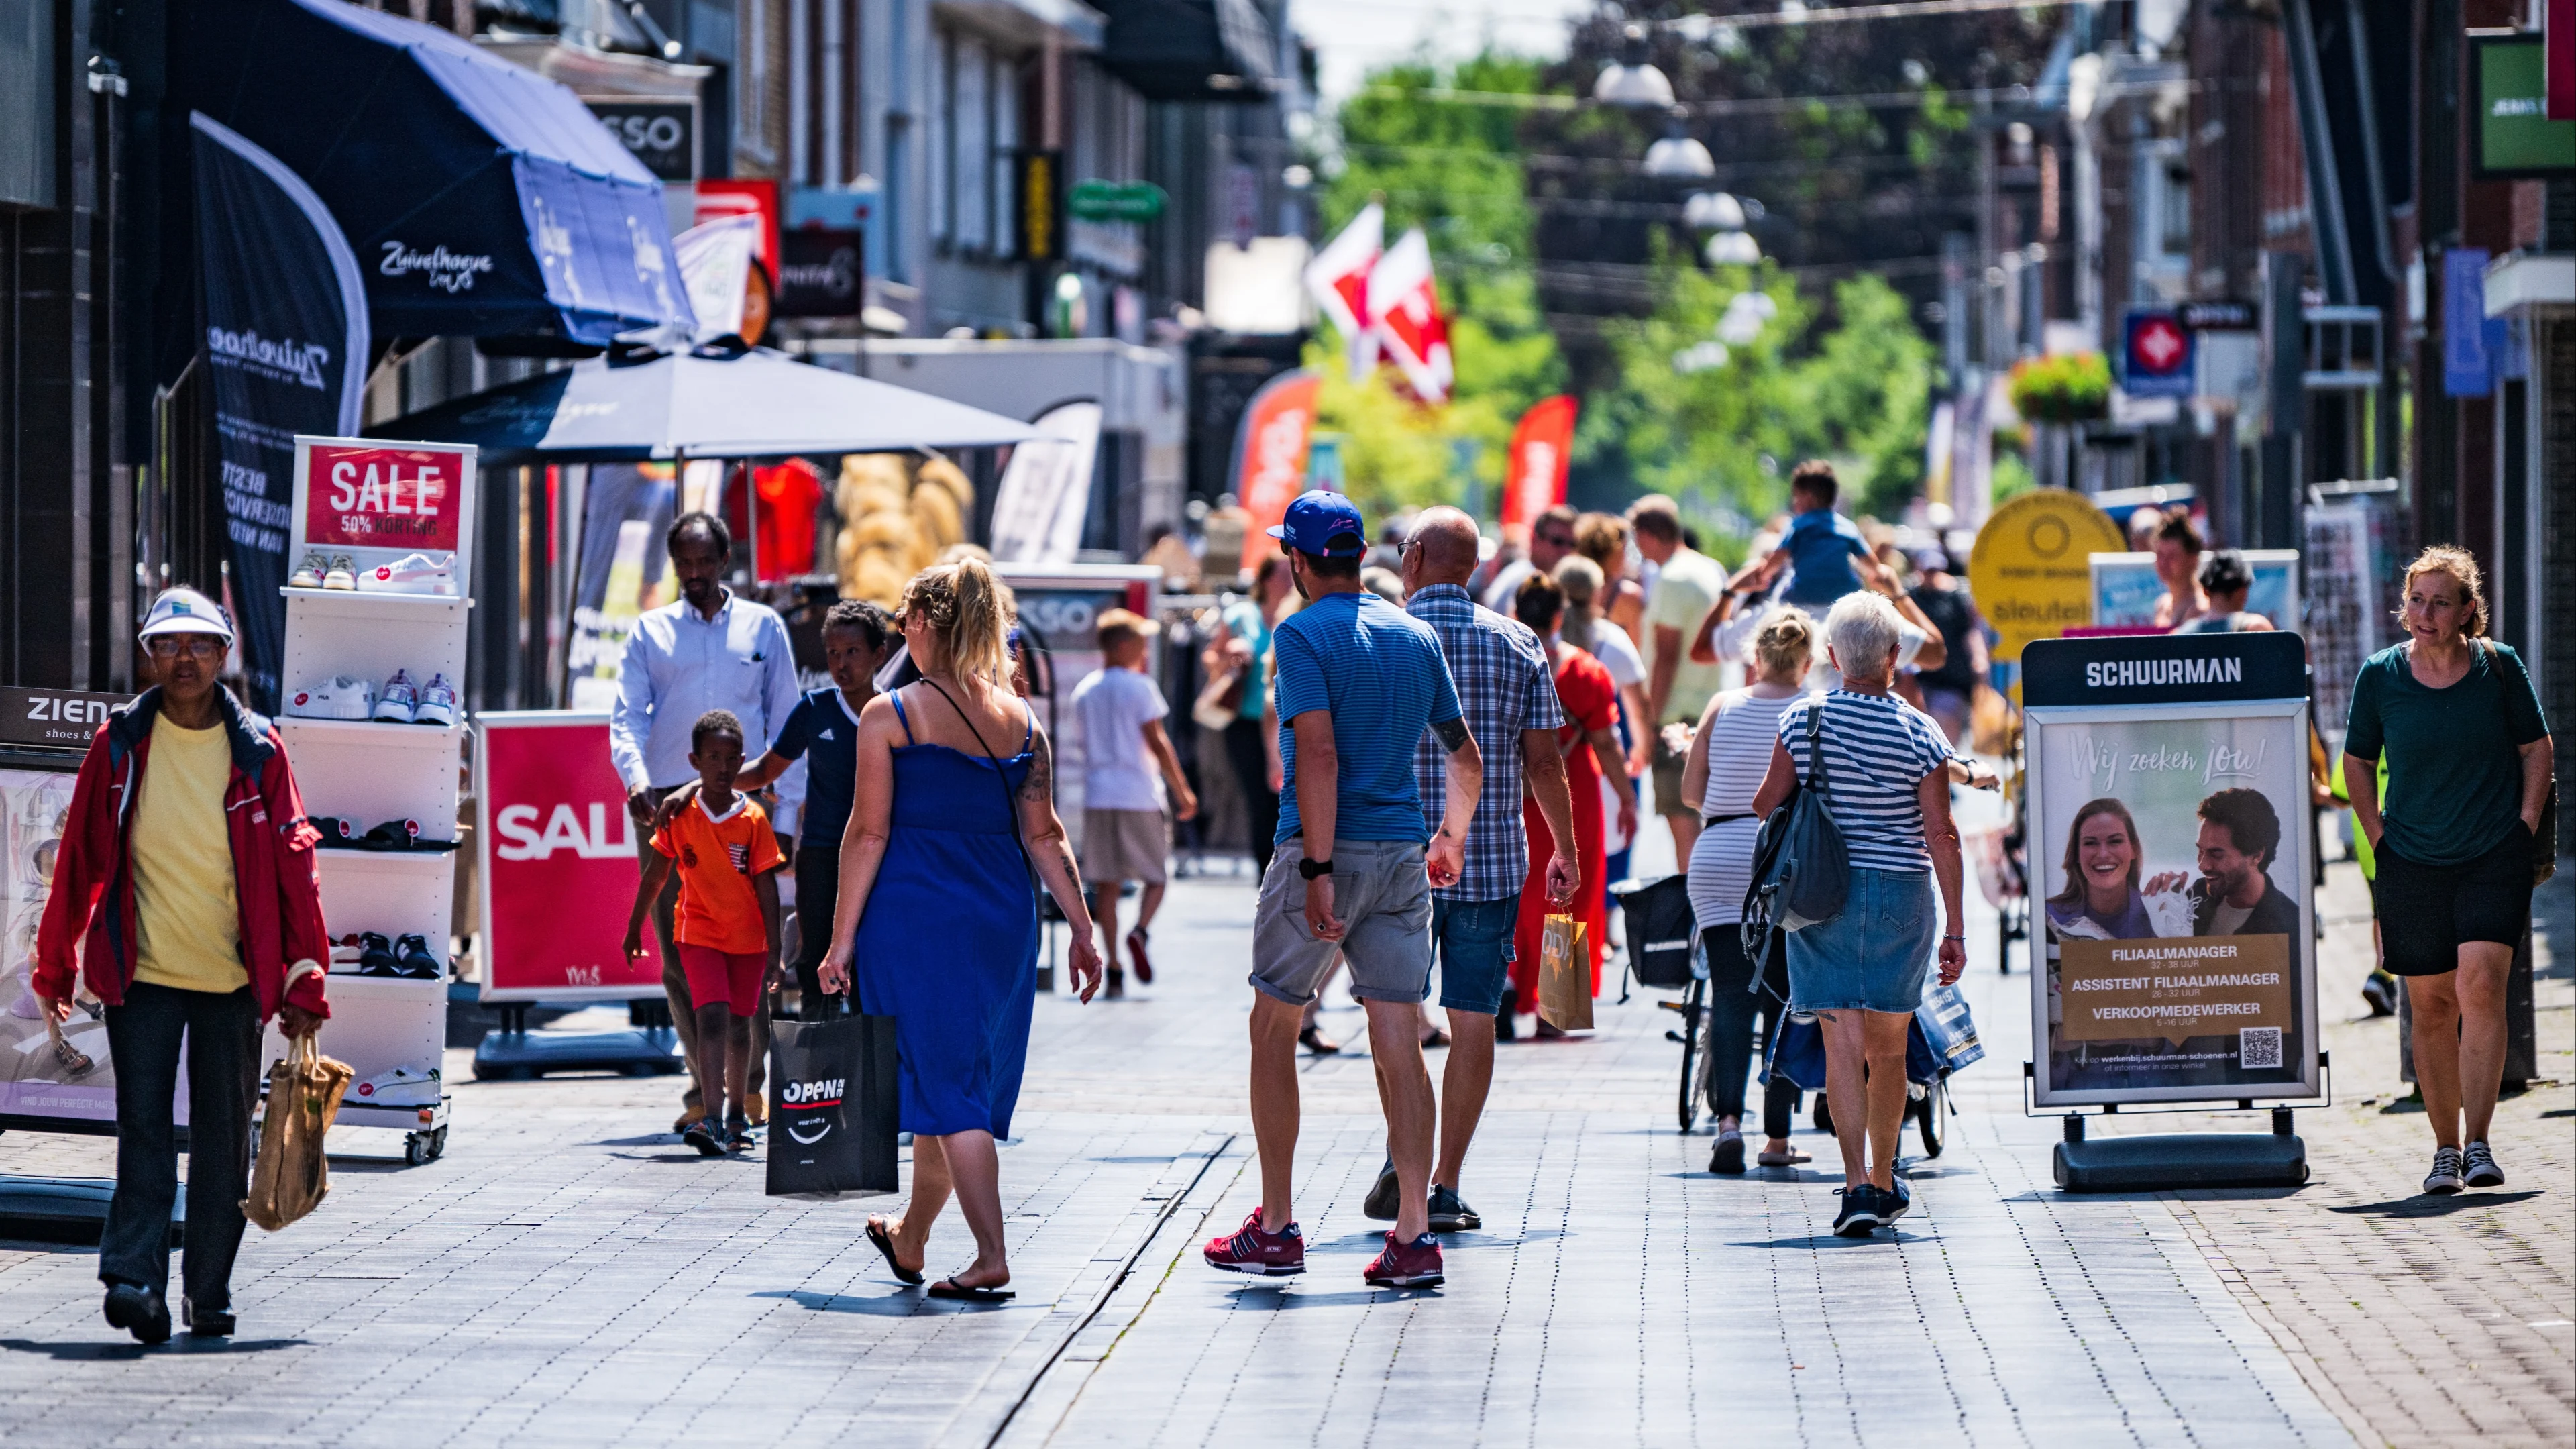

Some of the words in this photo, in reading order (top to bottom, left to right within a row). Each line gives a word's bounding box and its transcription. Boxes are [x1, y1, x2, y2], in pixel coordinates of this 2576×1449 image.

[329, 461, 441, 516] SALE
[341, 515, 372, 533] 50%
[375, 517, 438, 536] KORTING
[2086, 657, 2242, 687] SCHUURMAN
[28, 696, 134, 724] ZIEN
[46, 728, 79, 739] shoes
[83, 731, 92, 740] &
[2070, 732, 2118, 792] Wij
[2129, 743, 2197, 772] zoeken
[2201, 738, 2267, 786] jou!
[2112, 945, 2238, 961] FILIAALMANAGER
[2151, 961, 2161, 969] 32
[2181, 959, 2200, 968] UUR
[2072, 977, 2151, 991] ASSISTENT
[2154, 973, 2280, 989] FILIAALMANAGER
[2169, 989, 2180, 998] 32
[2182, 989, 2200, 997] UUR
[2092, 1003, 2261, 1020] VERKOOPMEDEWERKER
[2179, 1018, 2198, 1026] UUR
[2101, 1051, 2238, 1063] werkenbij.schuurman-schoenen.nl
[2114, 1063, 2151, 1072] informeer
[2181, 1061, 2208, 1070] winkel.
[20, 1096, 37, 1106] VIND
[38, 1097, 58, 1107] JOUW
[59, 1098, 93, 1109] PERFECTE
